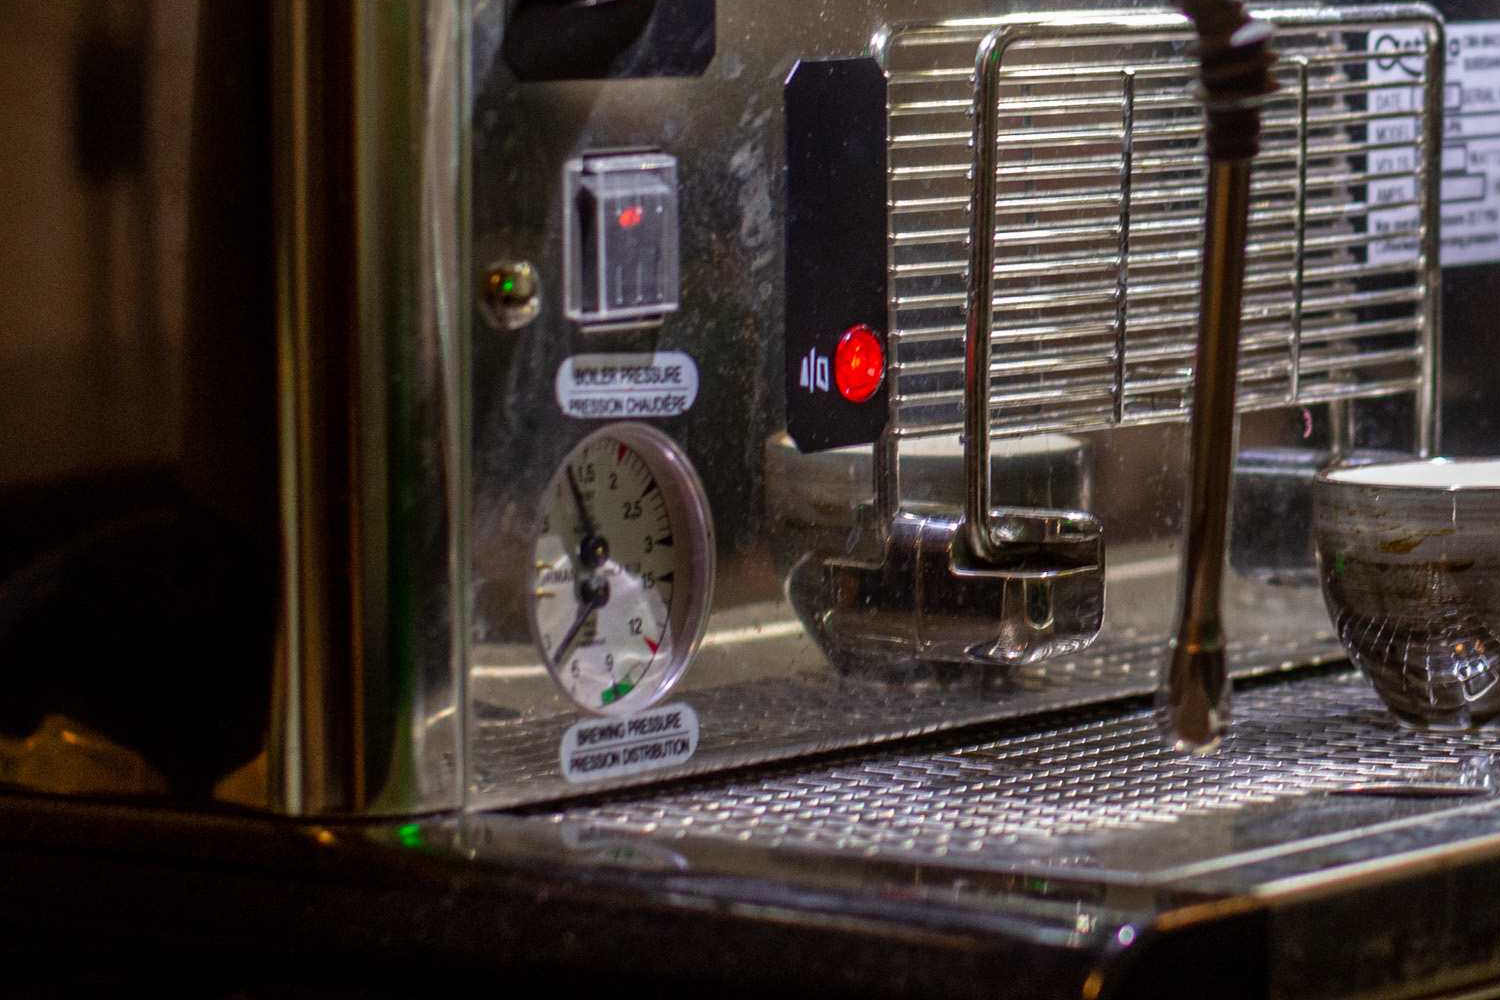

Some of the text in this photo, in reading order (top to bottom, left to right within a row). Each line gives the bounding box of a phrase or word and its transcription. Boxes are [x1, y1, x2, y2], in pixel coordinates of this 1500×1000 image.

[620, 364, 683, 385] PRESSURE
[569, 398, 623, 415] PRESSION
[609, 471, 619, 491] 2
[643, 534, 654, 554] 3
[628, 616, 643, 636] 12
[576, 711, 682, 747] BREWING PRESSURE
[569, 737, 690, 774] PRESSION DISTRIBUTION
